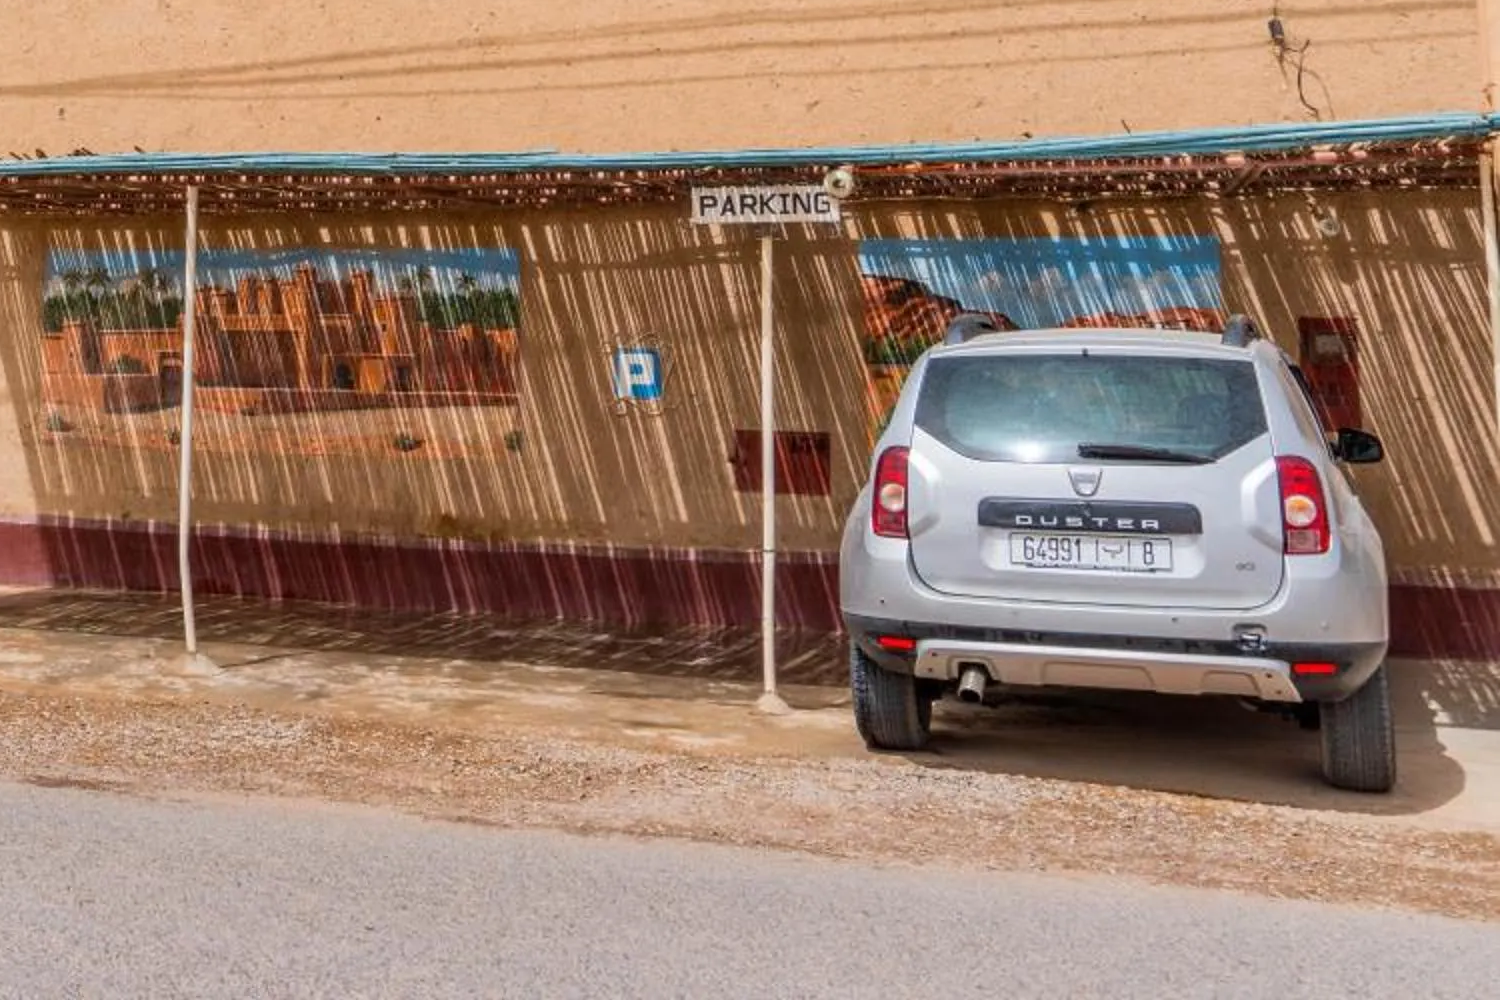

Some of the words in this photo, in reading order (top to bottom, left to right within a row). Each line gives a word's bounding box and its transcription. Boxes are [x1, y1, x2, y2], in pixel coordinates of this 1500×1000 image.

[700, 192, 831, 216] PARKING
[619, 353, 655, 398] P
[1015, 514, 1159, 530] DUSTER
[1023, 535, 1082, 562] 64991
